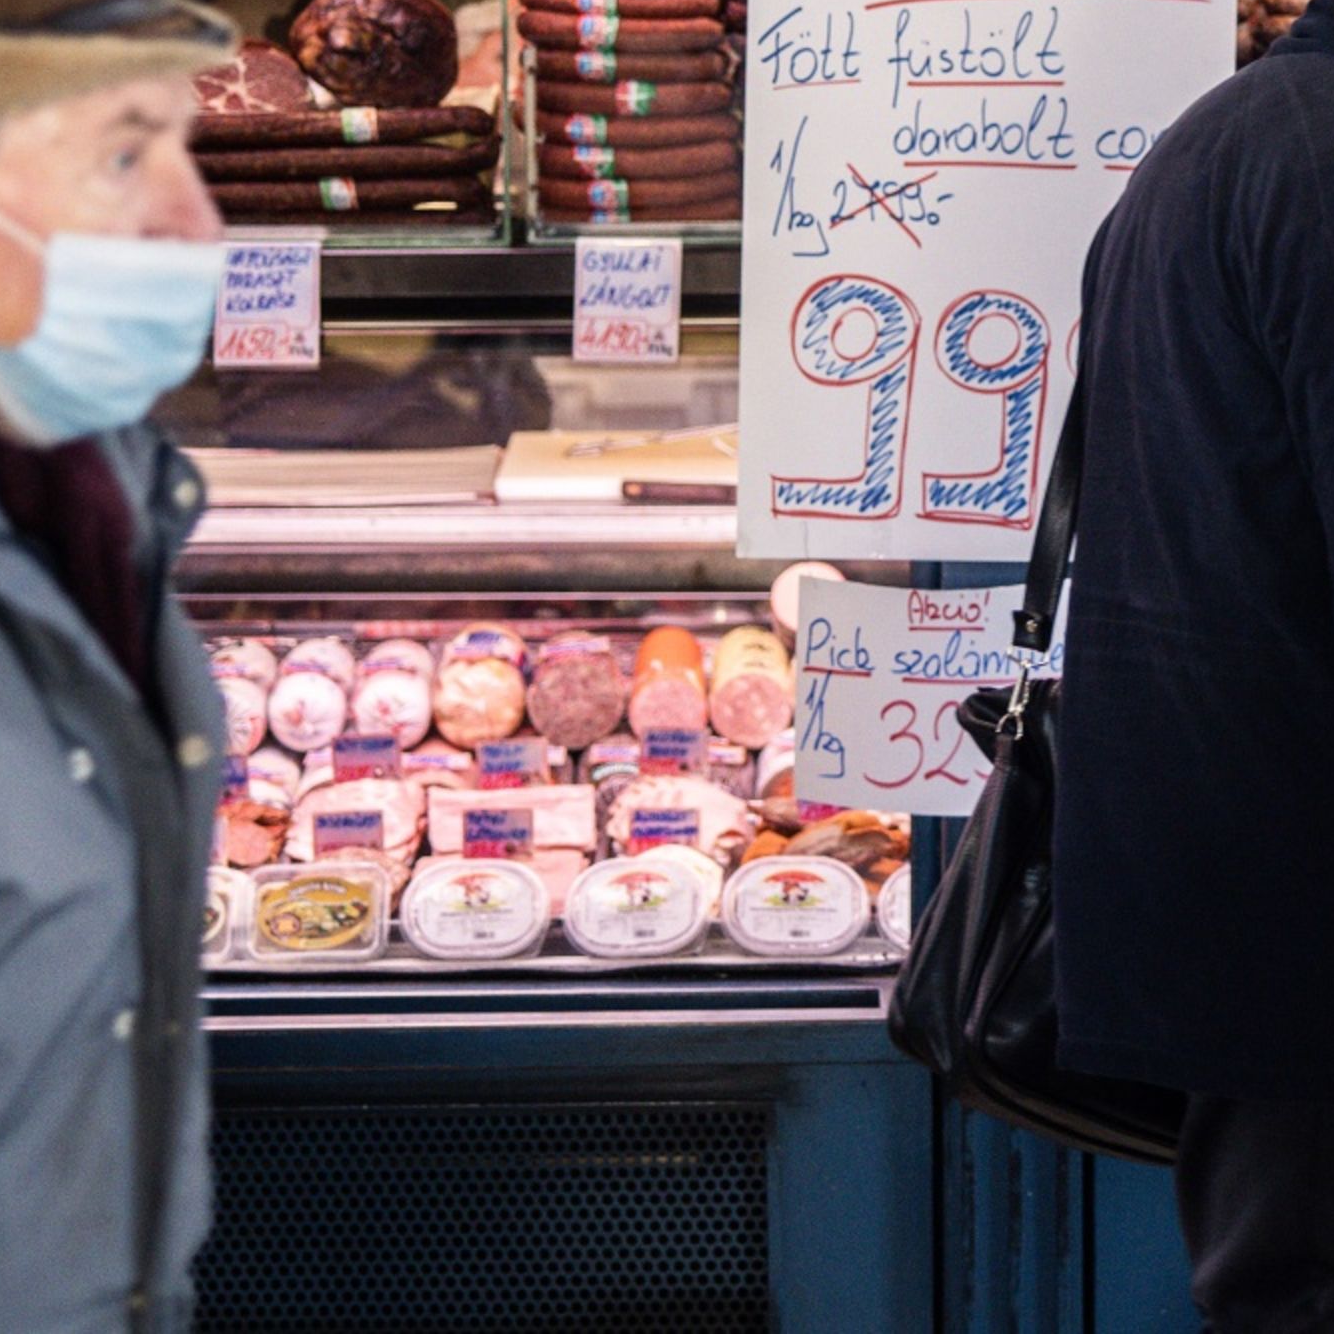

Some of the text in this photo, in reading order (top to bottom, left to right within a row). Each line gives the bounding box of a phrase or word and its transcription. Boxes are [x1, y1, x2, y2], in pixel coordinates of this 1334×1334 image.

[887, 8, 1067, 108] füstölt
[894, 95, 1078, 163] darabolt
[770, 272, 1080, 532] 99
[804, 617, 876, 672] Pick
